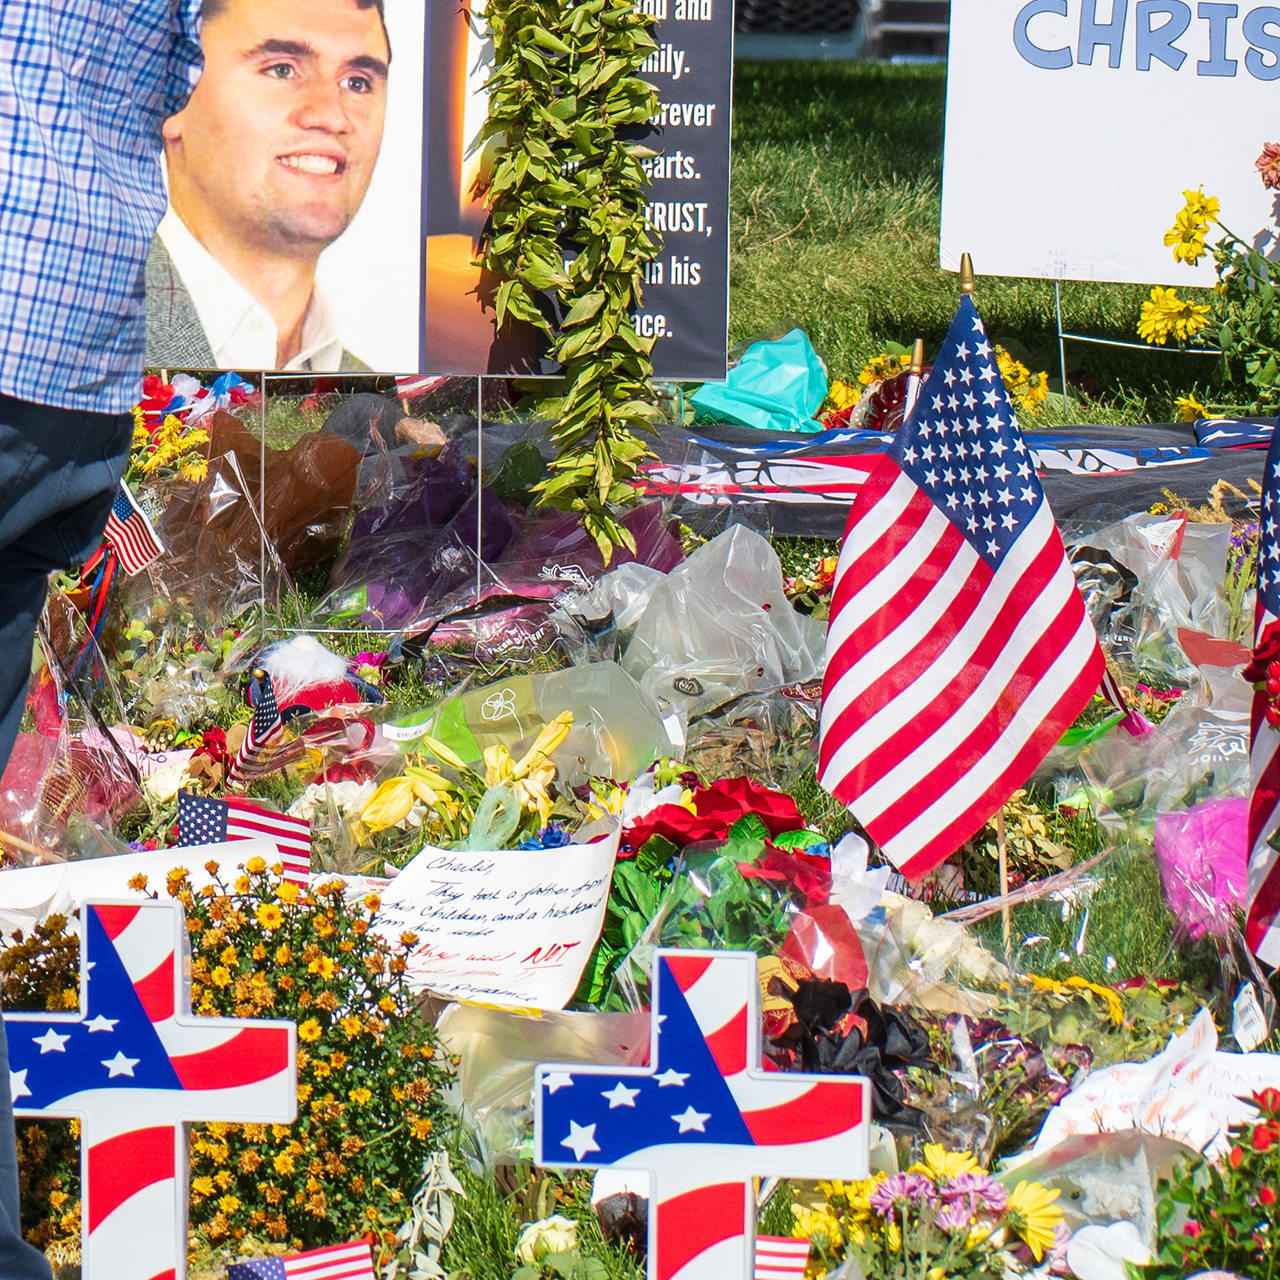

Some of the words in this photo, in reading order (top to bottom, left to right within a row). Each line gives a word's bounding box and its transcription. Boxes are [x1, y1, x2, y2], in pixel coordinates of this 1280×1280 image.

[641, 43, 690, 80] mily.
[642, 151, 702, 180] earts.
[643, 202, 713, 237] TRUST,
[670, 255, 702, 285] his
[630, 314, 673, 338] ace.
[426, 880, 465, 904] They
[506, 891, 516, 900] a
[520, 940, 582, 964] NOT
